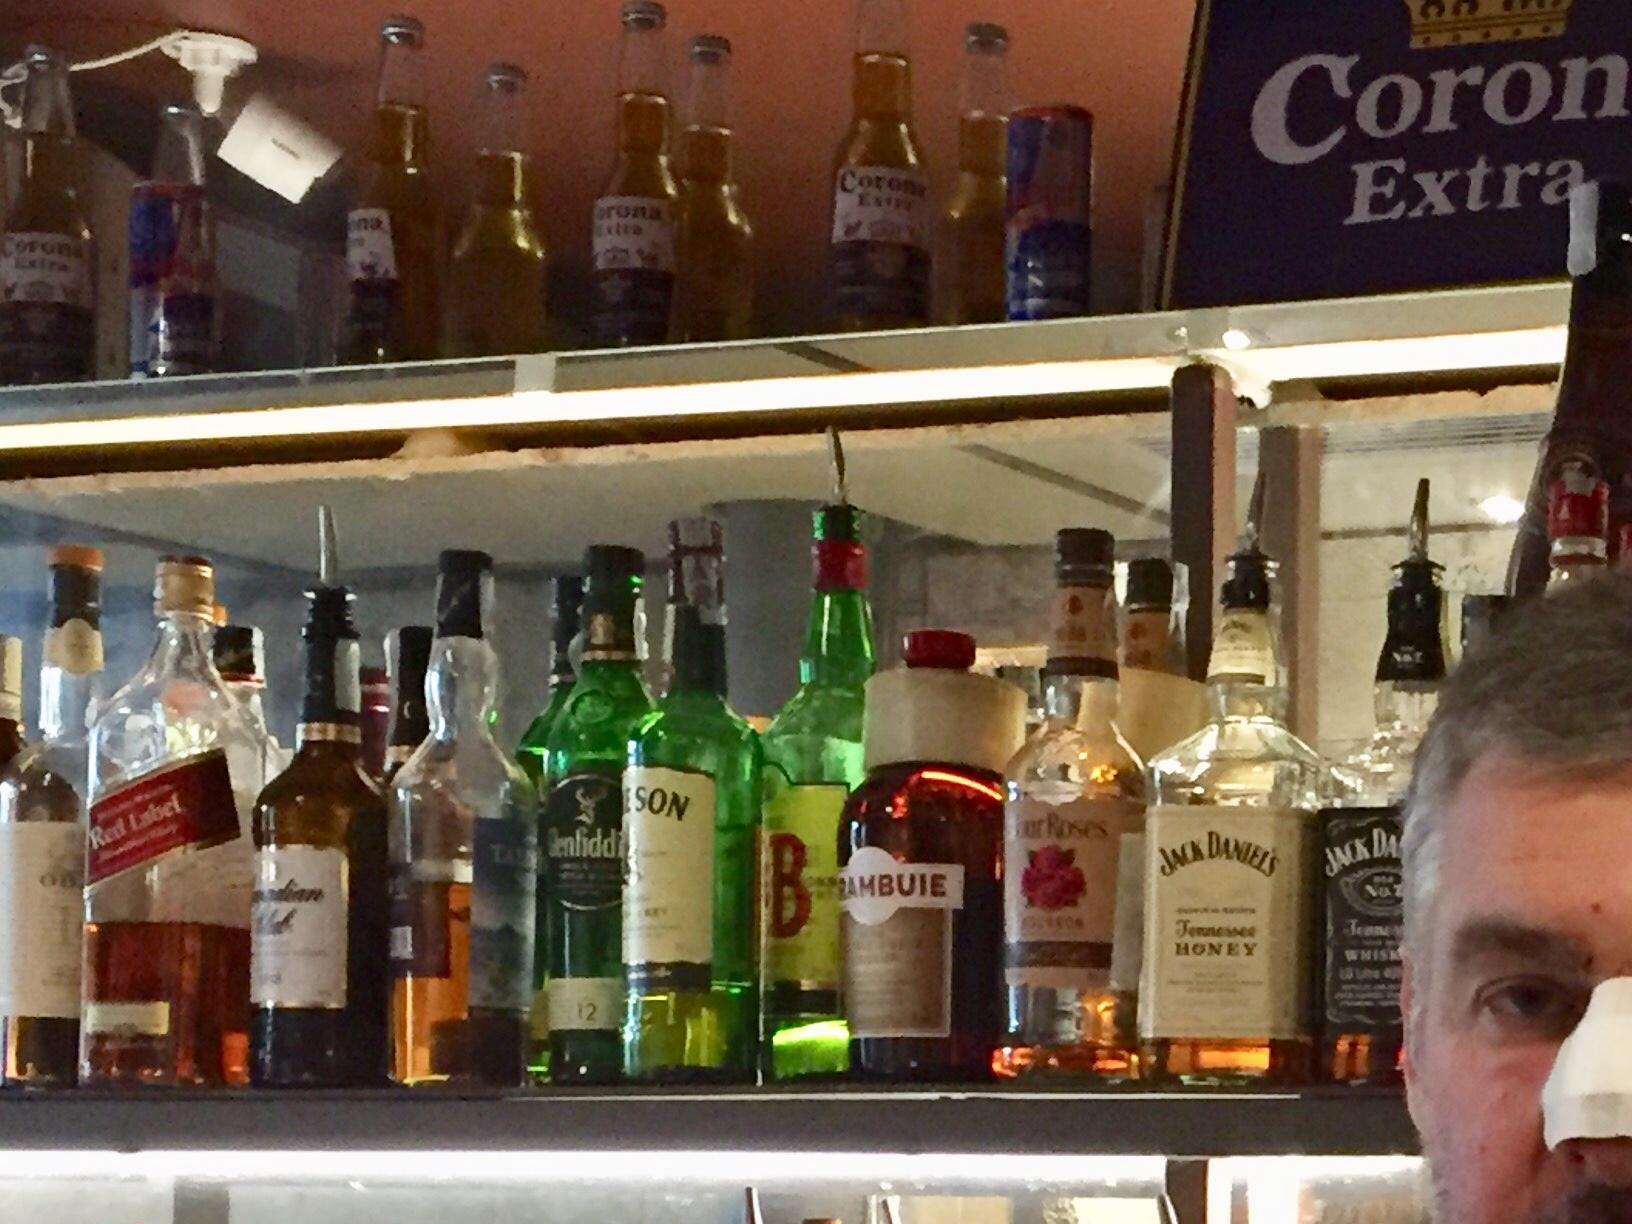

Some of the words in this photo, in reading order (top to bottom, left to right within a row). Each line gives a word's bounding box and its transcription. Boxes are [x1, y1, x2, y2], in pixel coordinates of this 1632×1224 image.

[1343, 155, 1583, 226] Extra
[596, 203, 662, 222] orona
[1159, 839, 1205, 878] JACK
[1207, 830, 1281, 878] DANIEL'S
[1325, 837, 1371, 878] JACK
[1175, 918, 1257, 938] Tennessee
[1174, 941, 1259, 957] HONEY
[577, 1003, 598, 1023] 12
